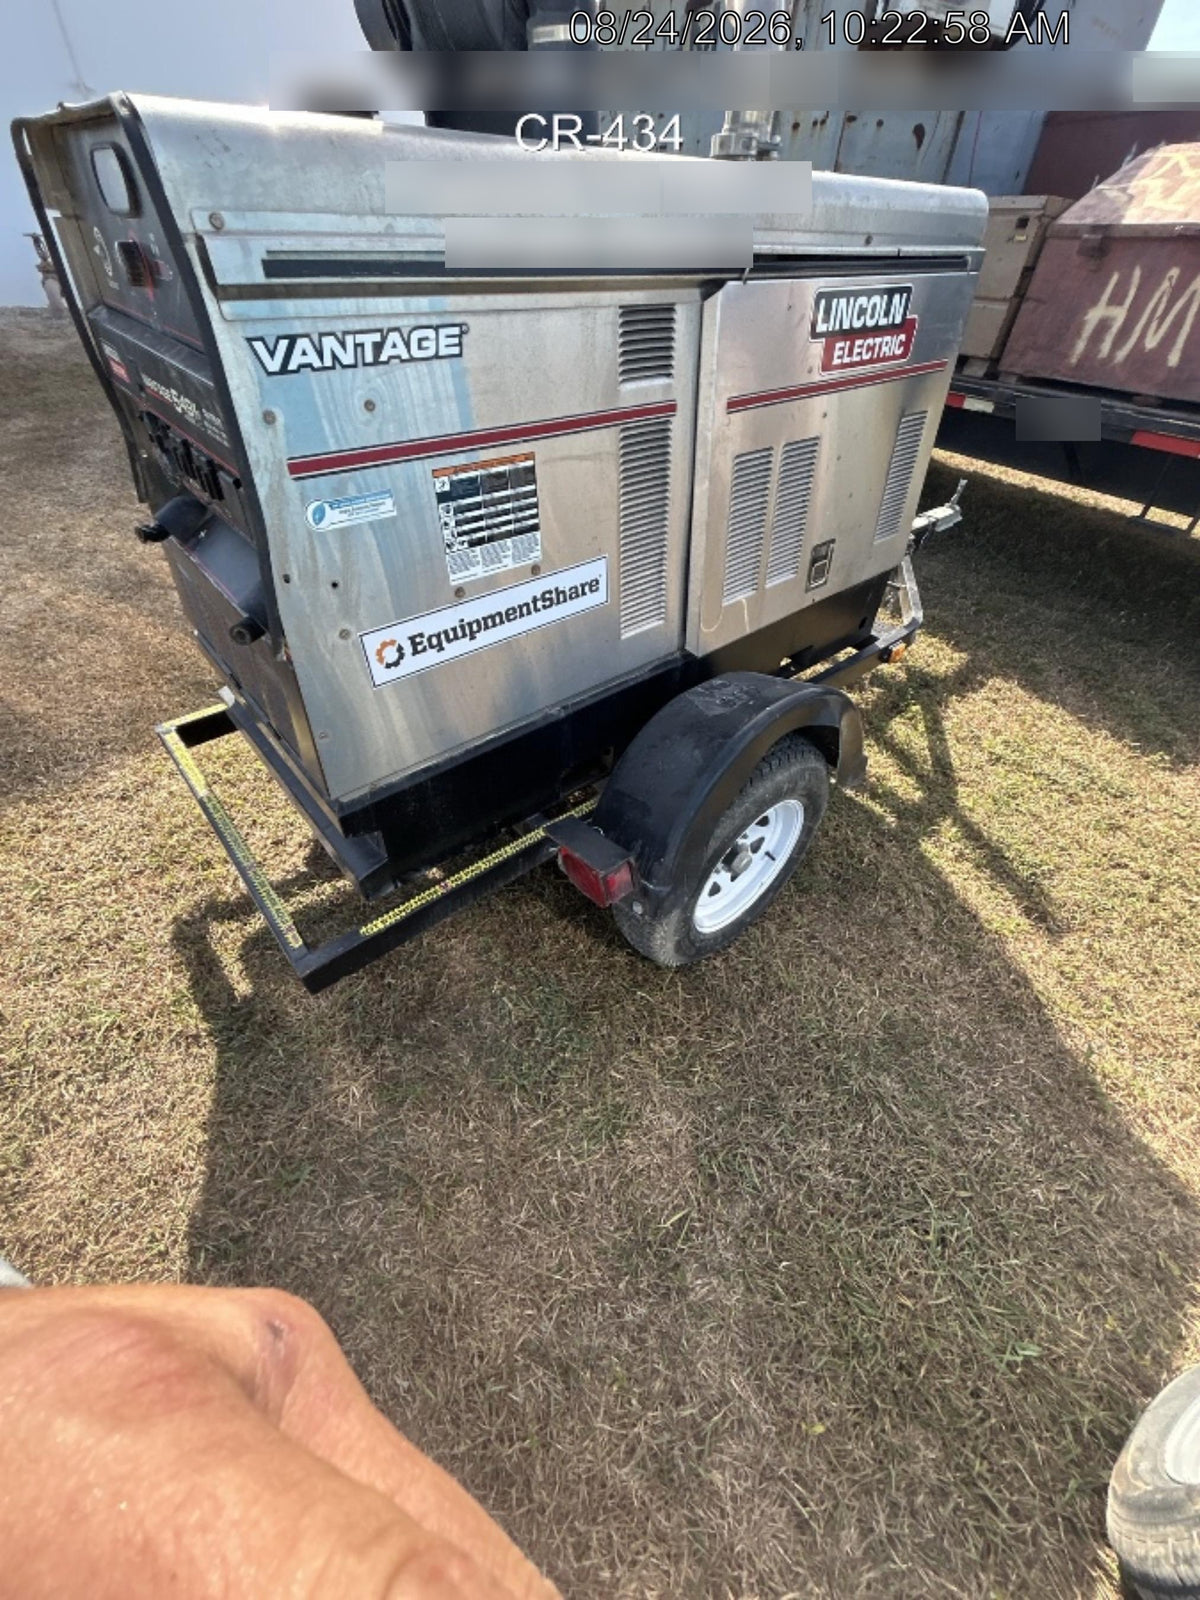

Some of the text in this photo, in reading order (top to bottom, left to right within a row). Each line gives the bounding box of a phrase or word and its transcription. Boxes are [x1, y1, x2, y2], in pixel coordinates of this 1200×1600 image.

[815, 293, 908, 333] LINCOLN
[831, 333, 906, 366] ELECTRIC
[407, 576, 600, 656] EquipmentShare
